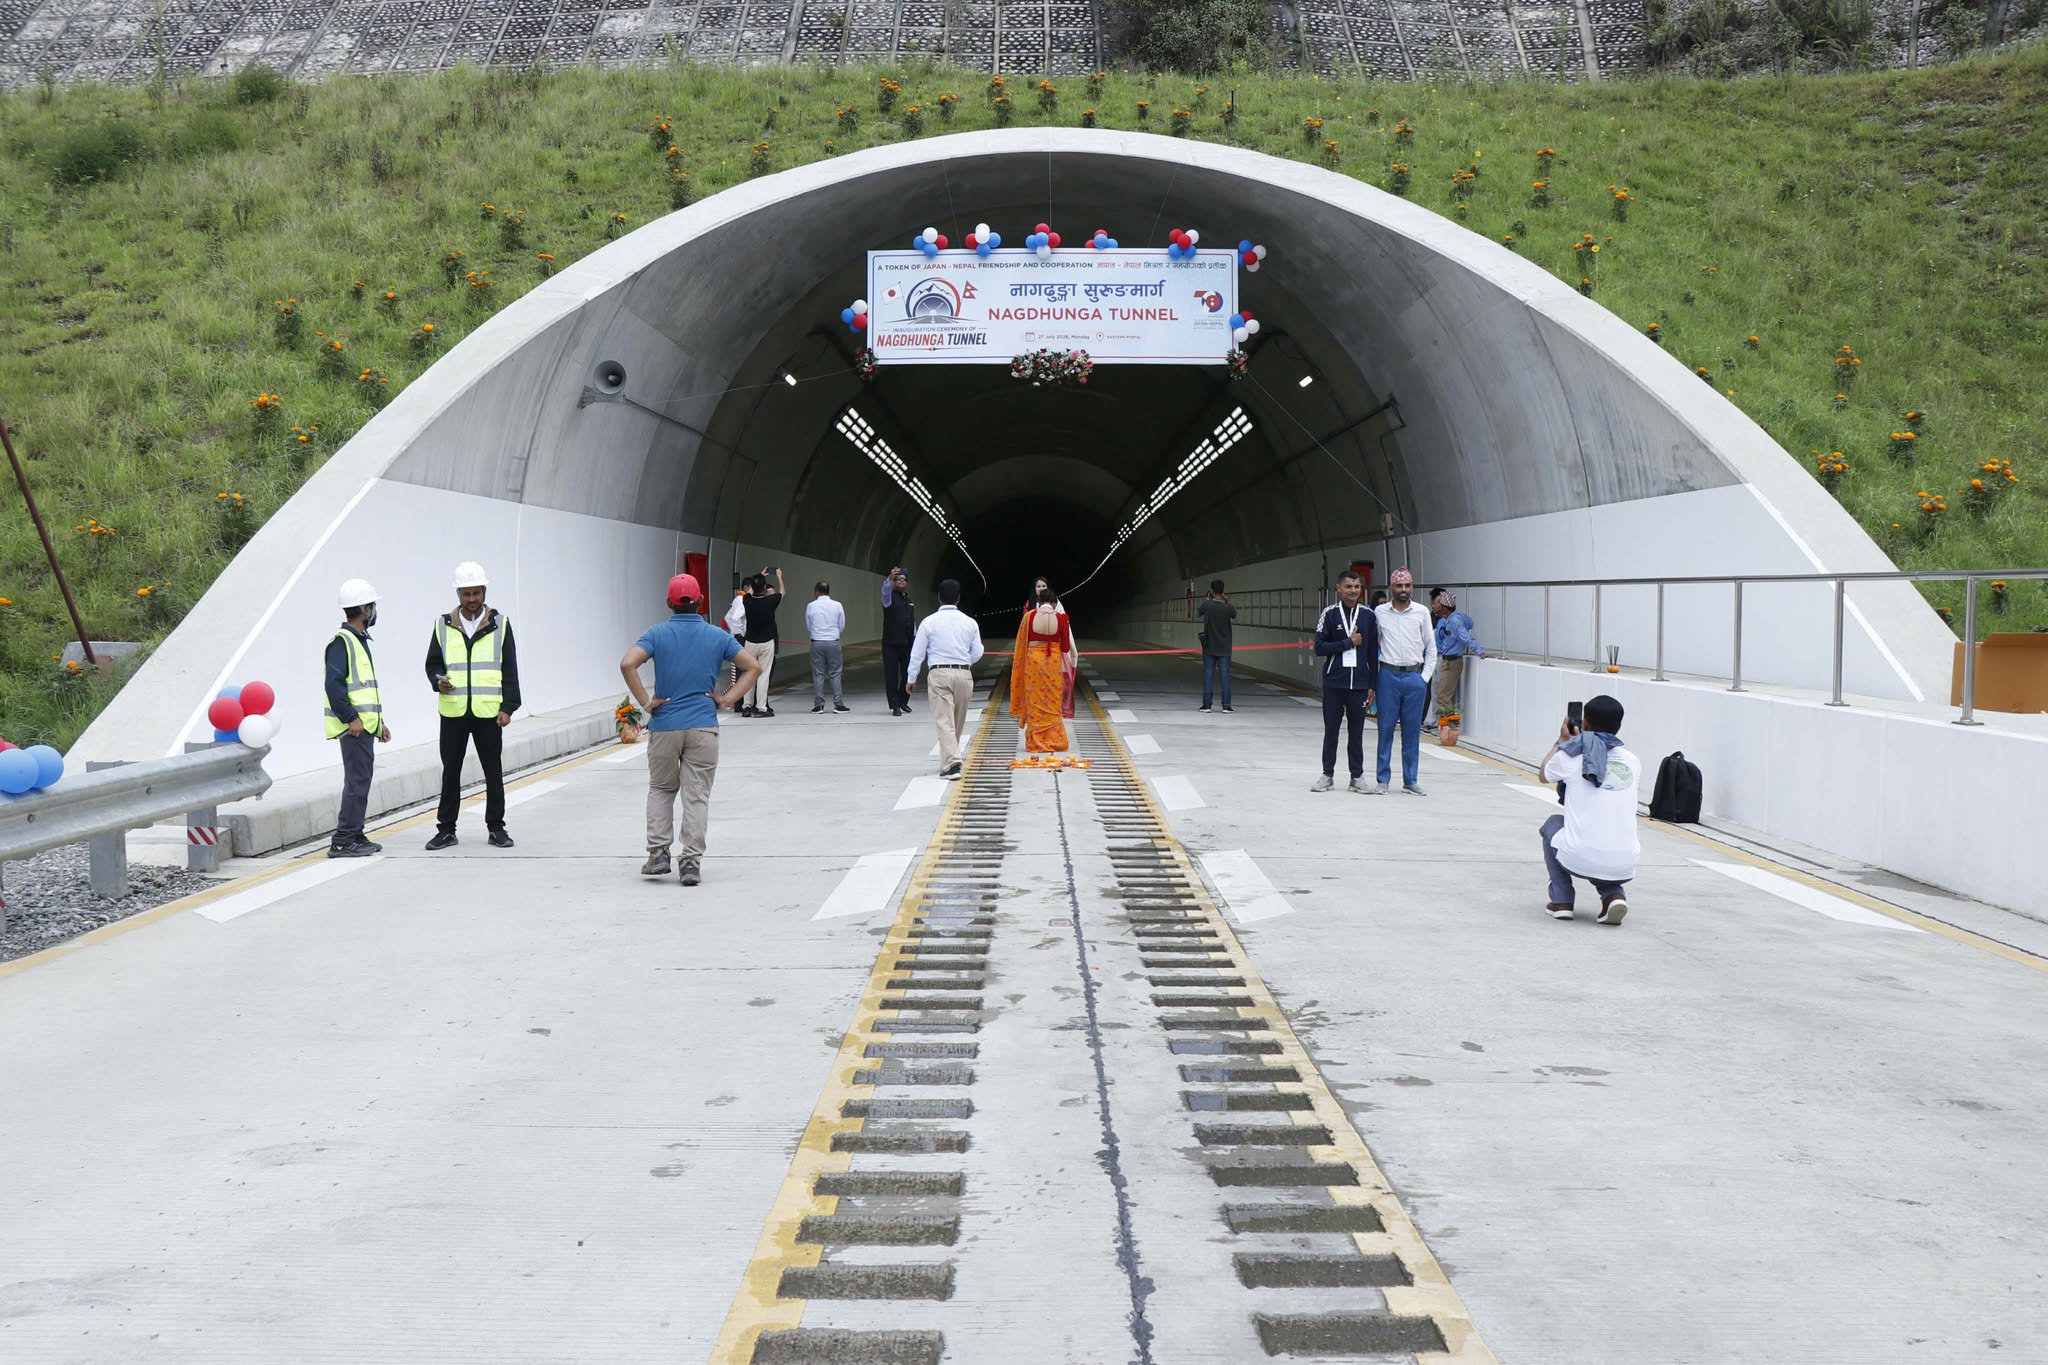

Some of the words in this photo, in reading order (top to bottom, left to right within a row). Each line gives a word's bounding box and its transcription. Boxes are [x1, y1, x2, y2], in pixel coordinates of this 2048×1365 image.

[988, 307, 1103, 321] NAGDHUNGA
[1109, 307, 1179, 321] TUNNEL
[876, 333, 944, 347] NAGDHUNGA
[947, 332, 988, 346] TUNNEL
